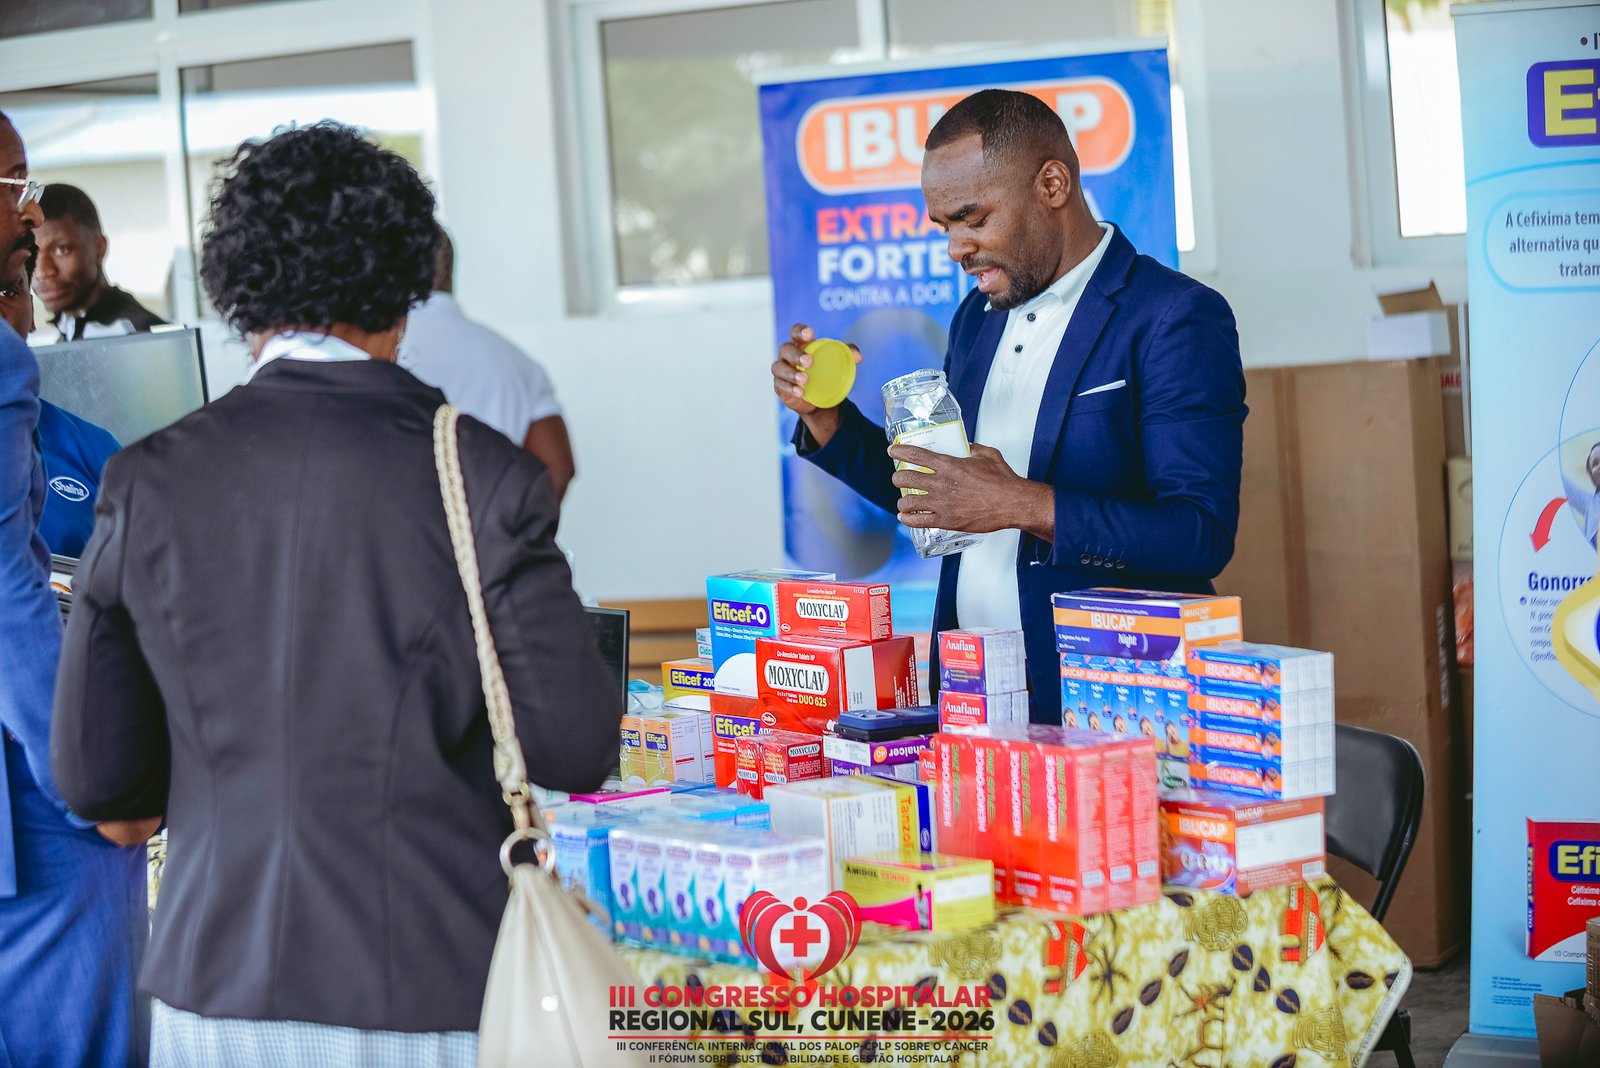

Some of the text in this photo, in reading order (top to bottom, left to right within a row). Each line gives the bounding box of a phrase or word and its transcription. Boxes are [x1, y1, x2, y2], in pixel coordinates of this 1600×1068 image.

[817, 203, 947, 244] EXTRA
[1505, 209, 1600, 228] A Cefixima tem
[1510, 236, 1579, 253] alternativa
[818, 240, 953, 284] FORTE
[819, 280, 954, 311] CONTRA A DOR
[54, 480, 85, 497] Shalina
[799, 601, 845, 619] MOXYCLAV
[1090, 612, 1136, 631] IBUCAP
[946, 640, 976, 652] Anaflam
[1118, 633, 1138, 649] Night
[672, 670, 701, 686] Eficef
[768, 665, 825, 691] MOXYCLAV
[1205, 662, 1244, 677] IBUCAP
[798, 694, 828, 708] DUO 625
[945, 701, 981, 716] Anaflam
[1205, 698, 1245, 713] IBUCAP
[715, 717, 756, 737] Eficef
[646, 733, 666, 743] Eficef
[1205, 732, 1245, 747] IBUCAP
[790, 744, 819, 756] MOXYCLAV
[1206, 766, 1245, 781] IBUCAP
[941, 743, 952, 827] HEMOFORCE
[975, 747, 987, 832] HEMOFORCE
[1010, 750, 1022, 837] HEMOFORCE
[1045, 754, 1058, 842] HEMOFORCE
[1235, 807, 1263, 820] IBUCAP
[1179, 817, 1227, 838] IBUCAP
